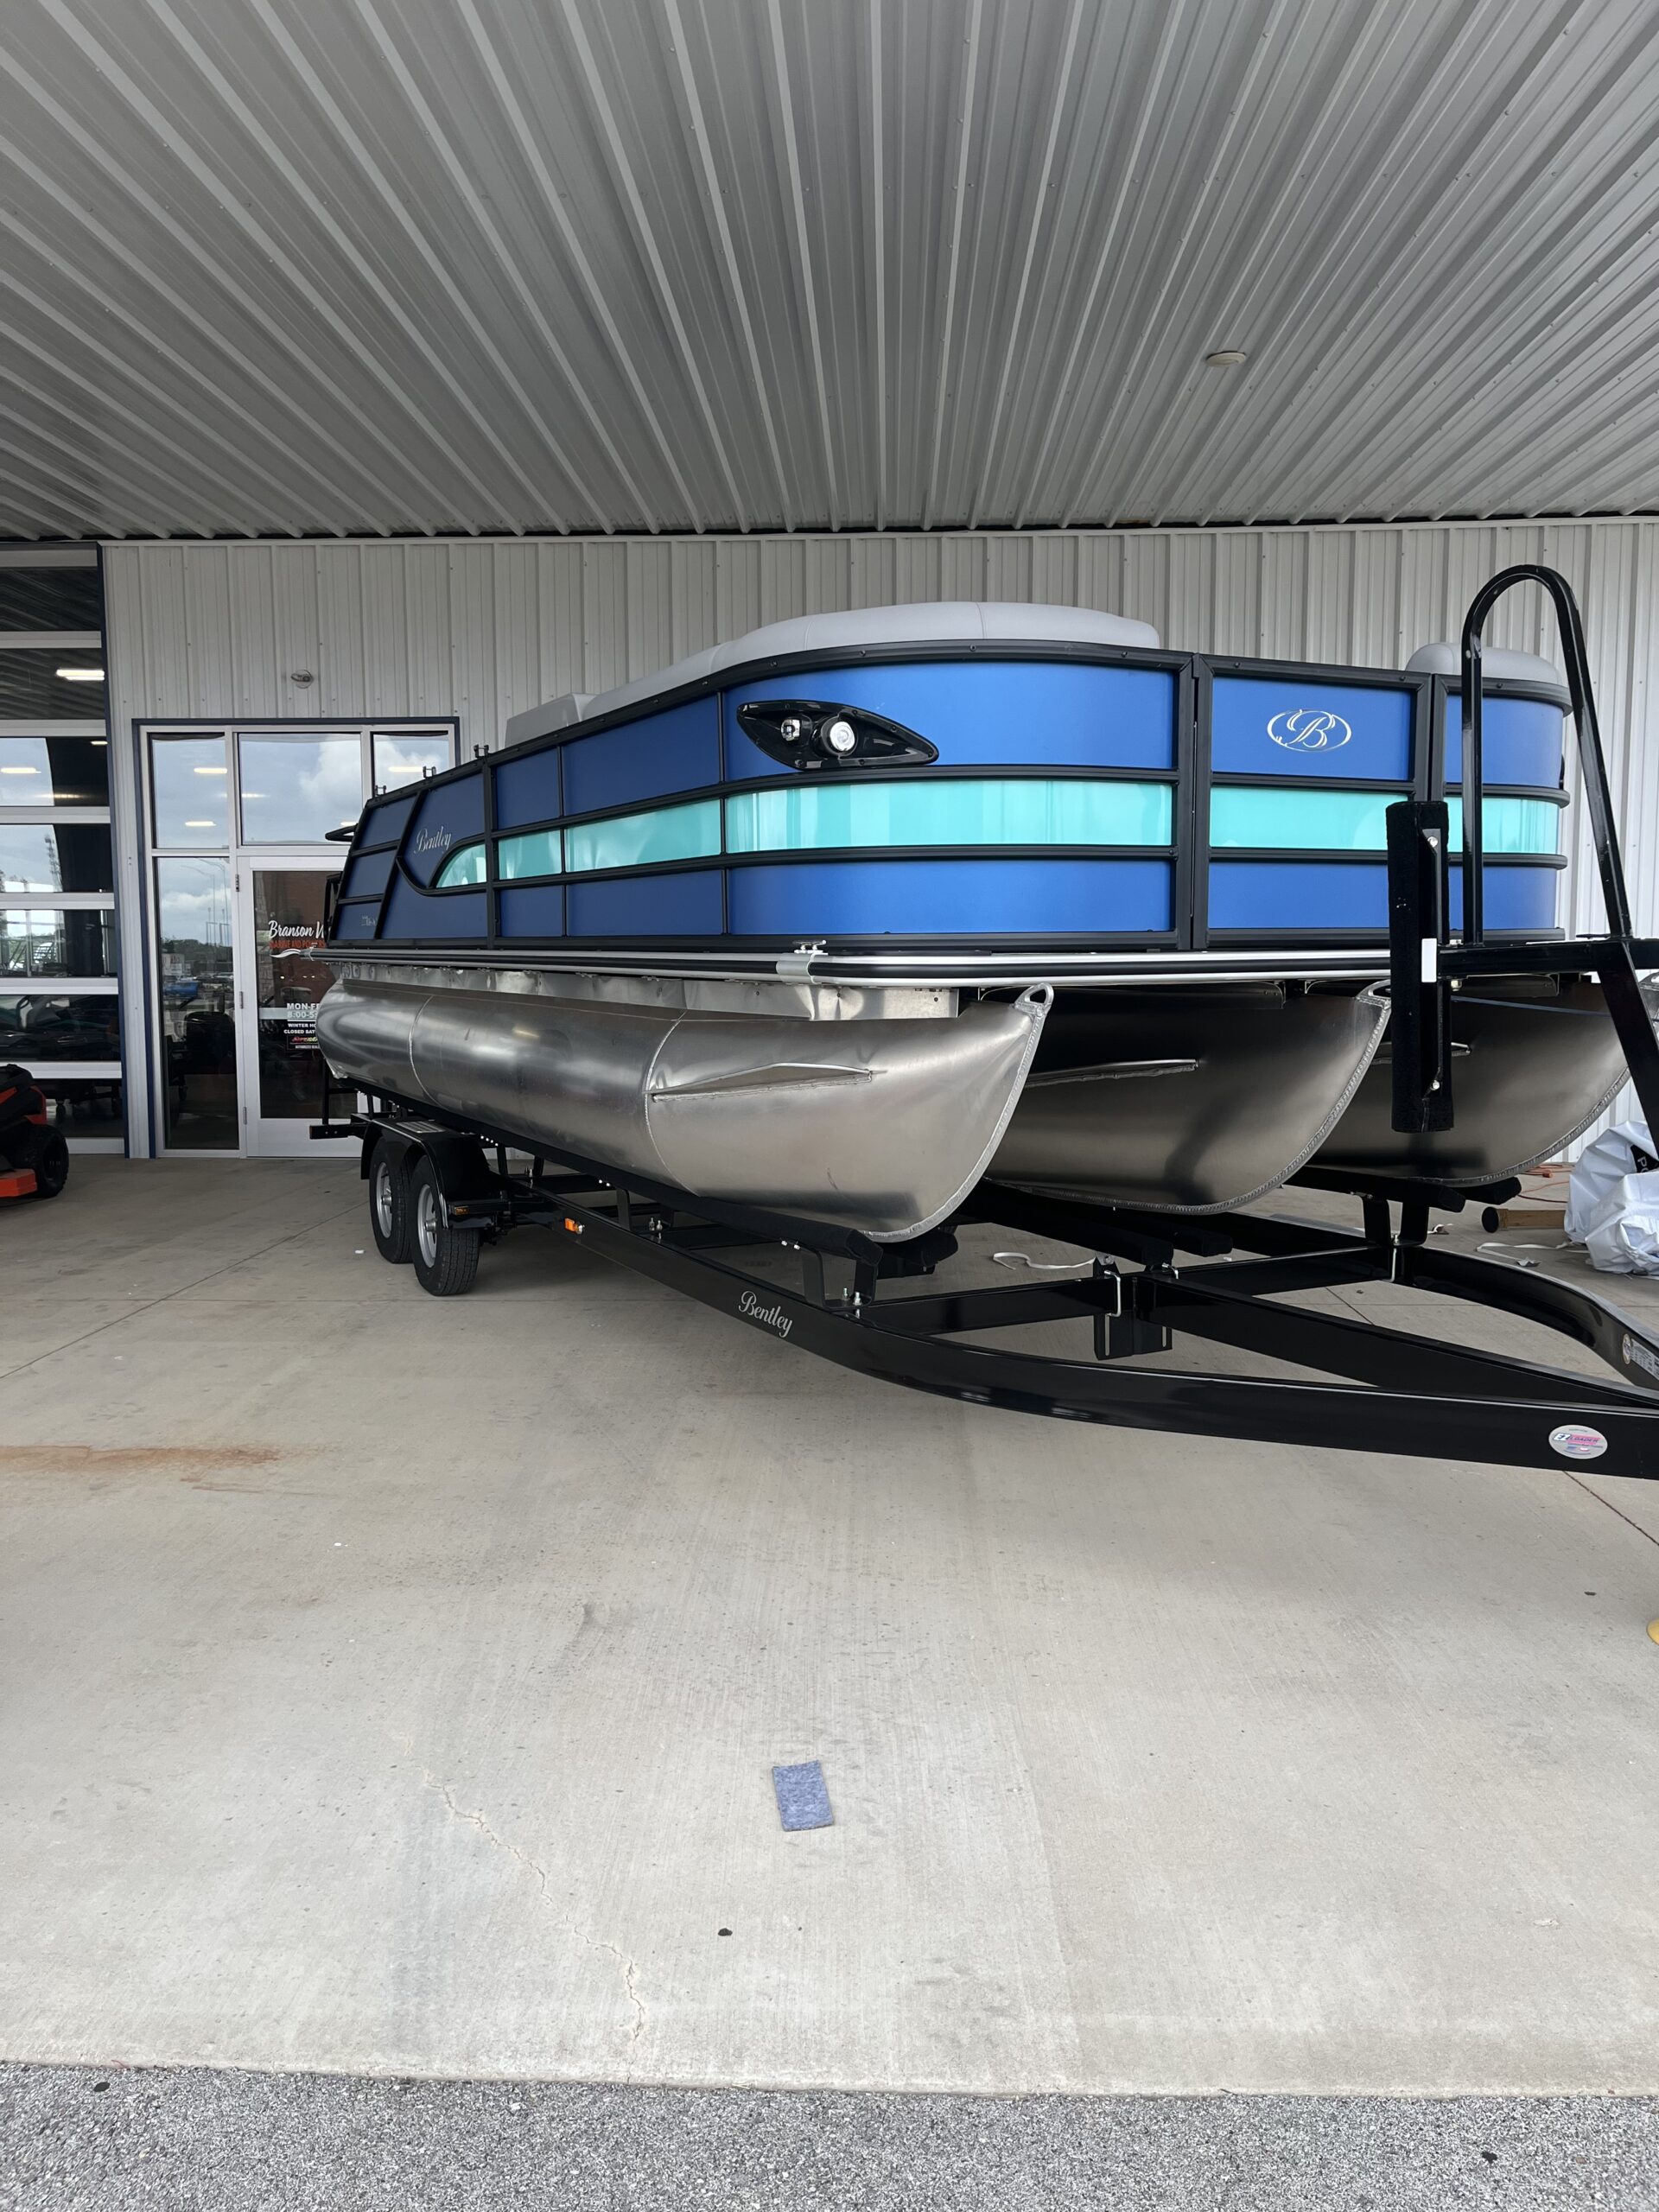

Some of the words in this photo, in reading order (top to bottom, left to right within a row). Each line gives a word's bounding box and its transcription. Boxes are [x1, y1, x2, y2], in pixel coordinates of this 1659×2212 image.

[414, 825, 451, 854] Bentley
[268, 920, 314, 938] Branson
[738, 1290, 793, 1338] Bentley
